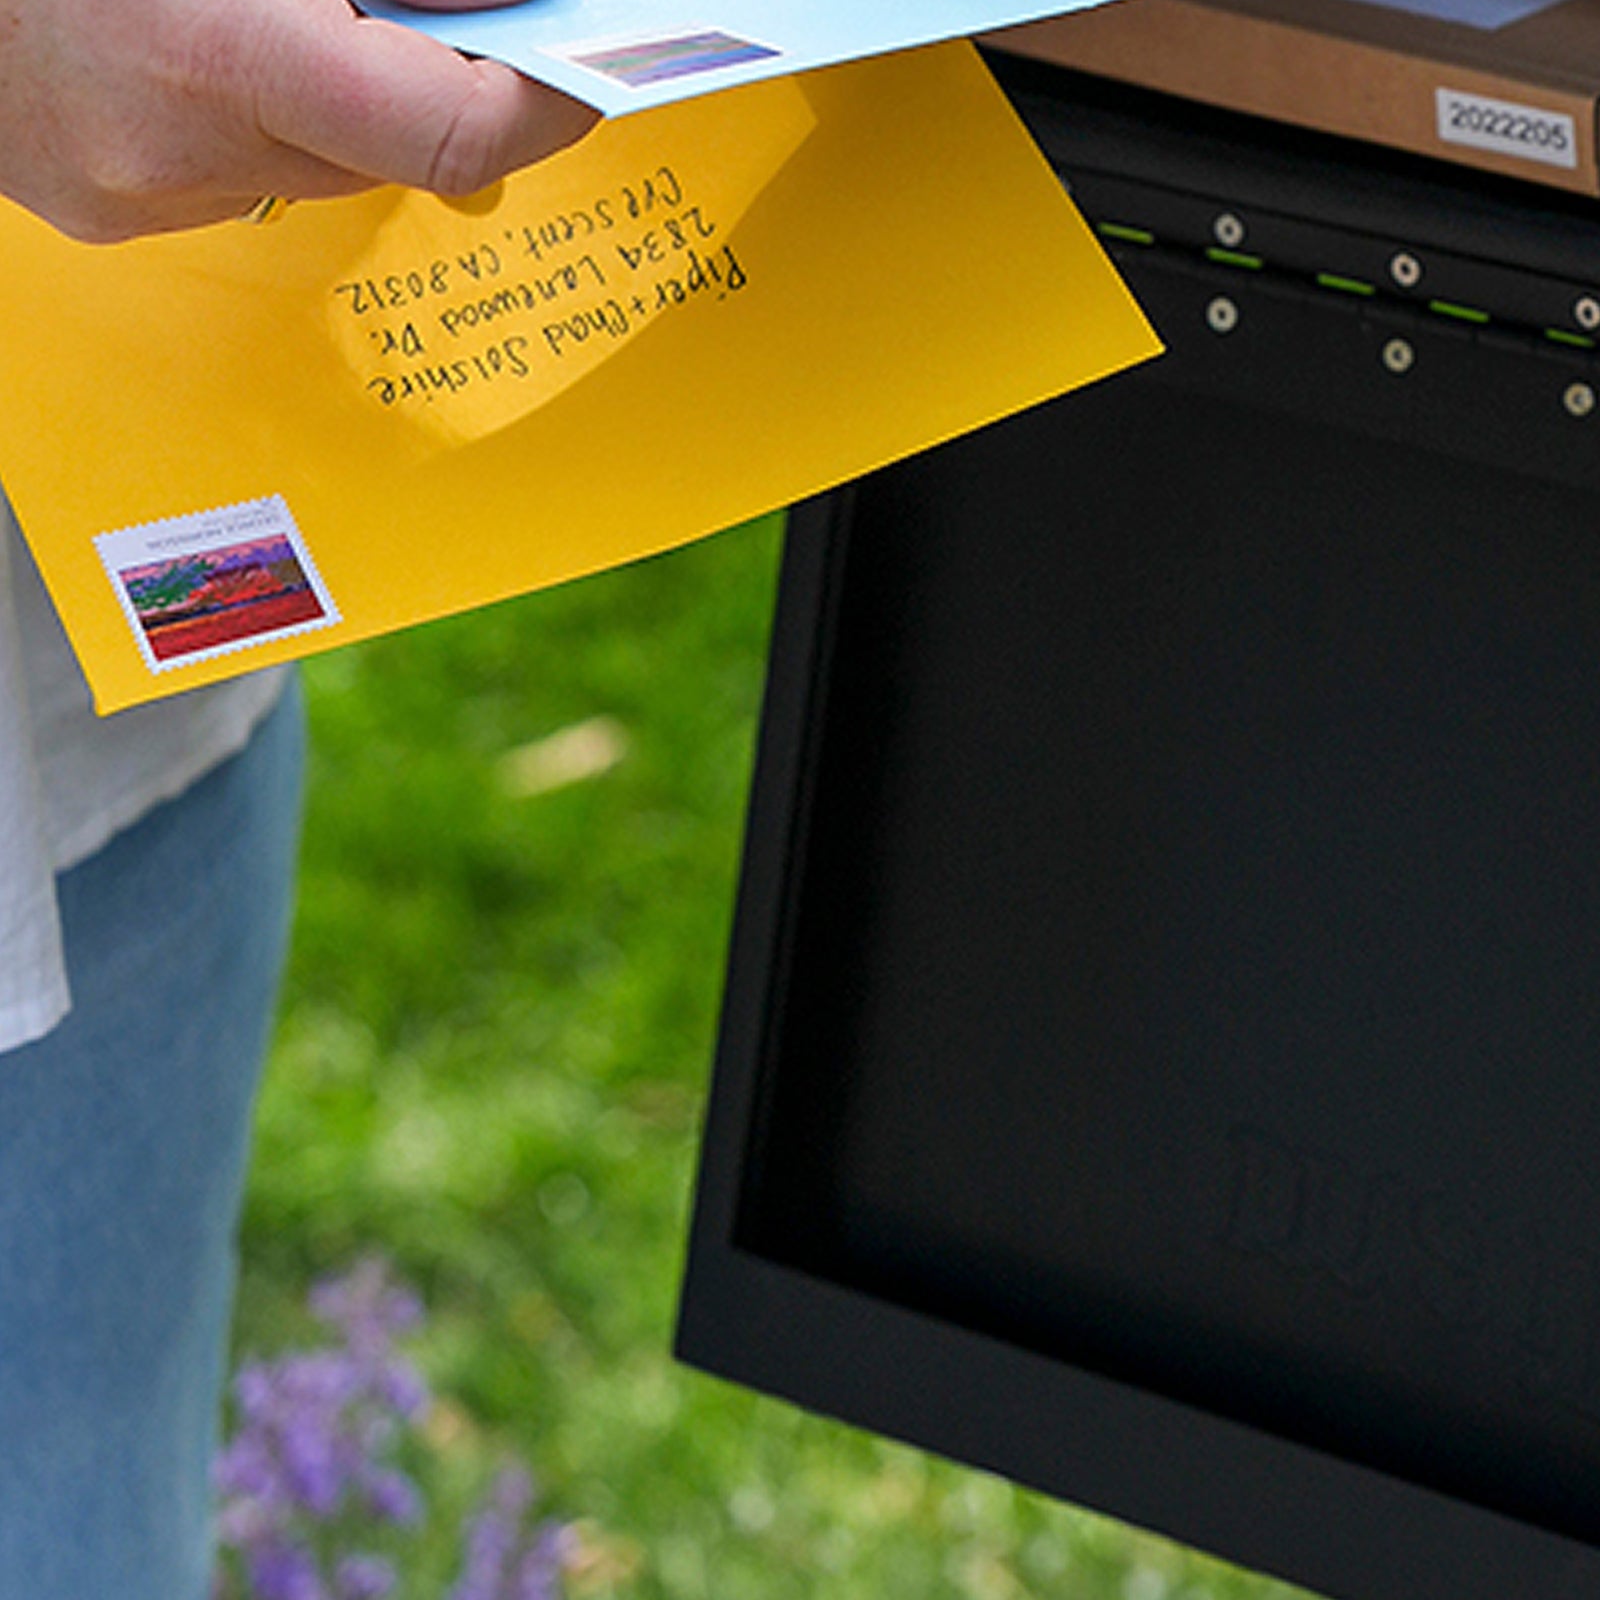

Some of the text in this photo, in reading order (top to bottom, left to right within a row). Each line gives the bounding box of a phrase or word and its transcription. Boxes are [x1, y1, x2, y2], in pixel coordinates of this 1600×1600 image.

[1450, 101, 1568, 150] 2022205
[335, 260, 450, 315] 80312
[370, 207, 716, 358] 2834 Lanewood Dr.
[459, 243, 501, 280] CA
